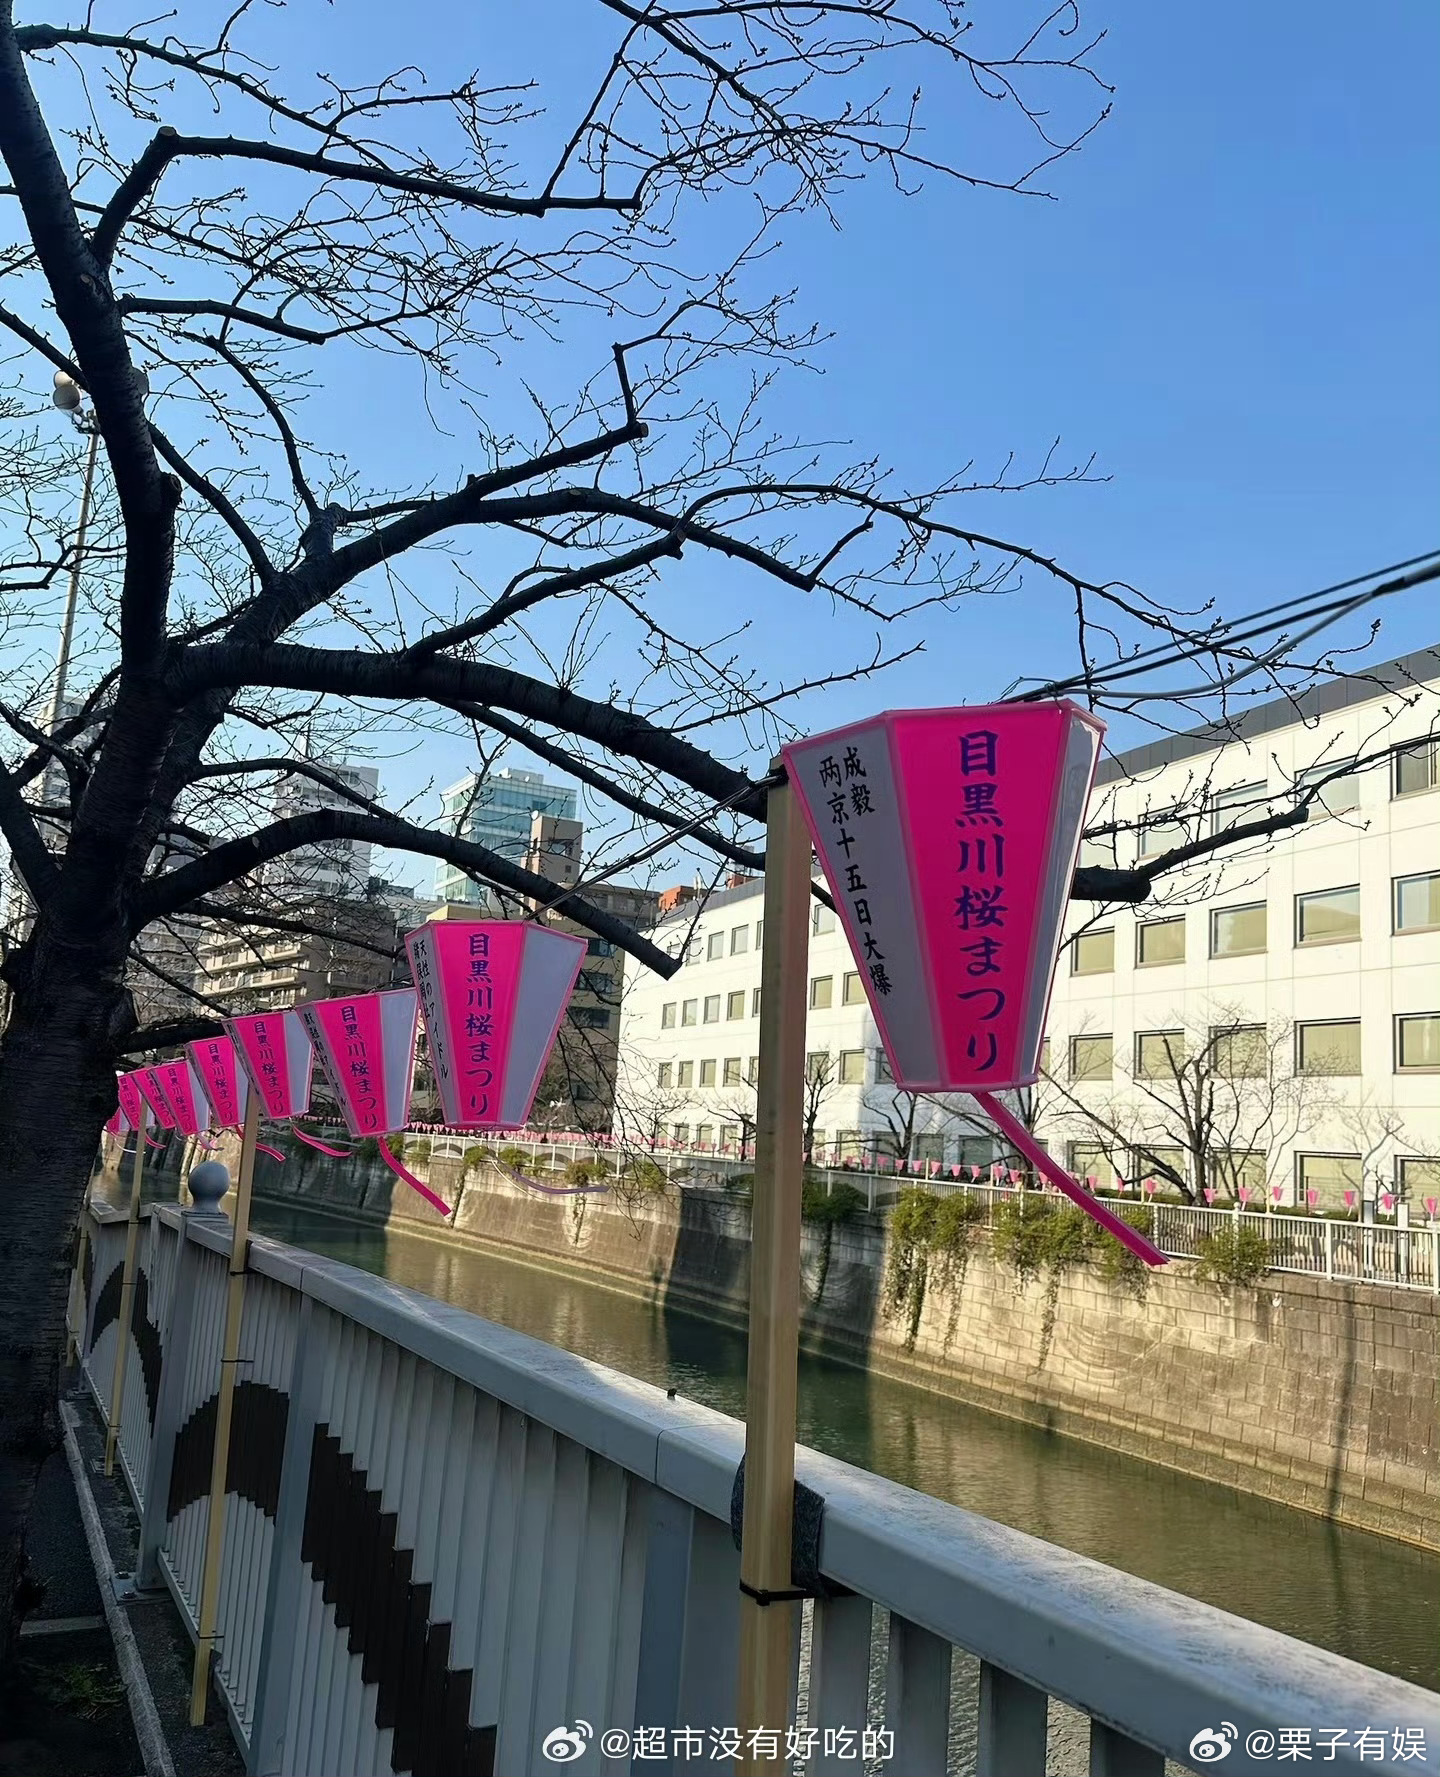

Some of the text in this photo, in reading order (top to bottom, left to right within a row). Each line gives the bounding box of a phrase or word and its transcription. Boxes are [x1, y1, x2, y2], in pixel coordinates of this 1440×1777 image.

[842, 746, 876, 817] 成毅
[818, 755, 894, 997] 两京十五日大爆
[955, 730, 1009, 1072] 目黒川桜まつり
[254, 1021, 284, 1113] 目黒川桜まつり
[341, 1005, 378, 1129] 目黒川桜まつり
[420, 939, 449, 1079] 天性のアイドル
[464, 932, 495, 1116] 目黒川桜まつり
[208, 1043, 233, 1121] 目黒川桜まつり
